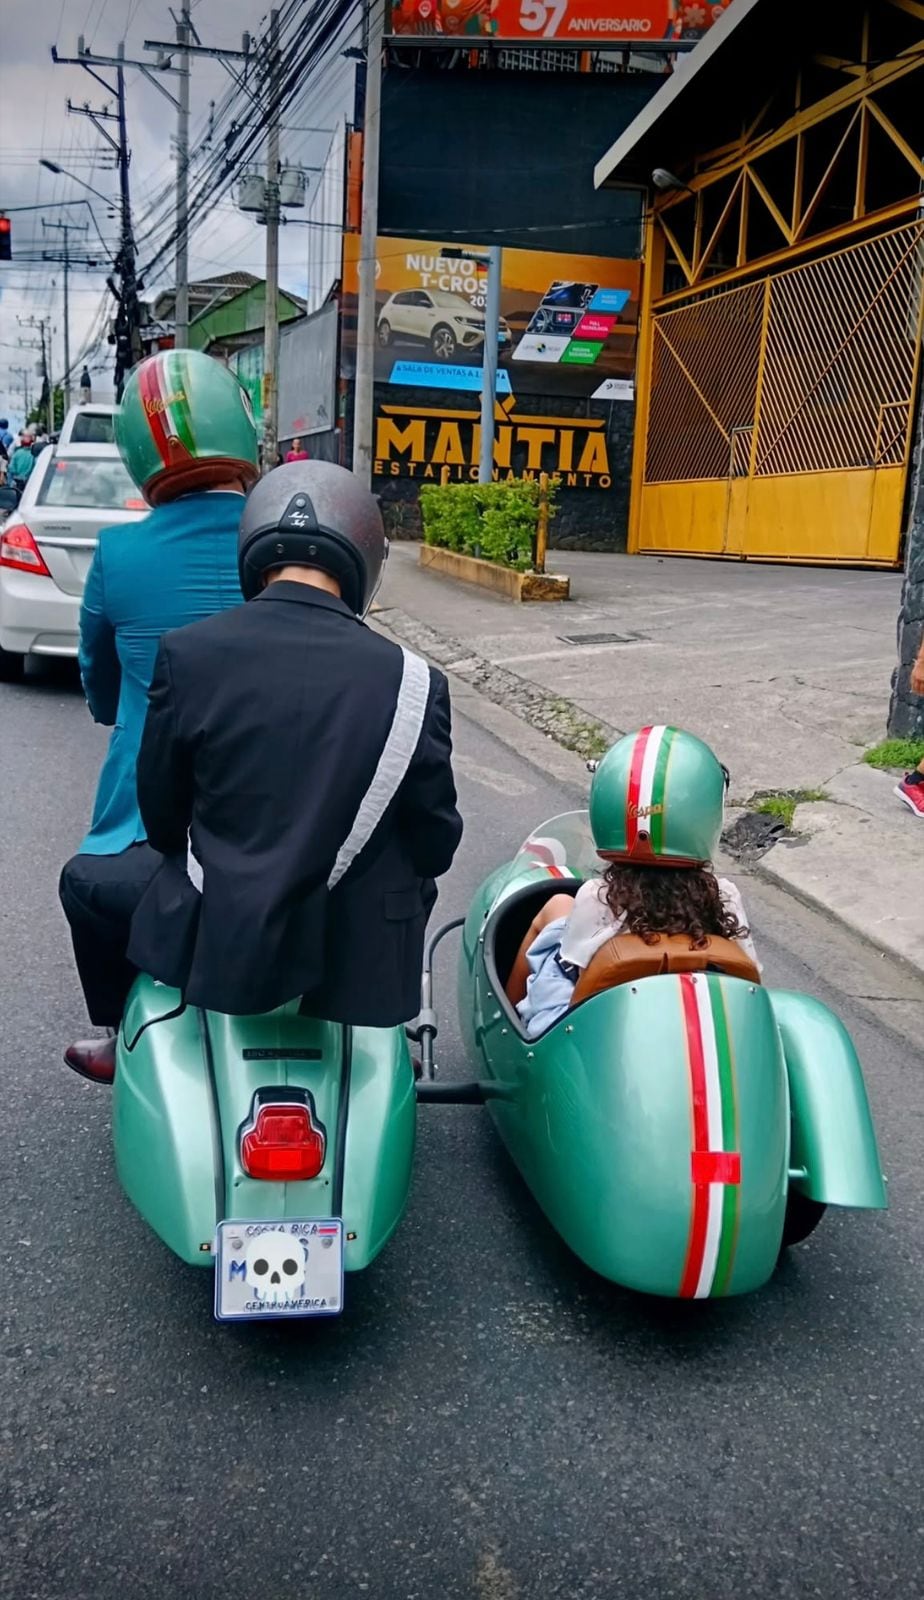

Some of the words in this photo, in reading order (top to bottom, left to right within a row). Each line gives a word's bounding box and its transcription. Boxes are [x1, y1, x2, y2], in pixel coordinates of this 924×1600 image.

[519, 0, 568, 37] 57
[568, 18, 651, 32] ANIVERSARIO
[406, 254, 475, 276] NUEVO
[419, 272, 488, 295] T-CROS
[424, 366, 433, 374] DE
[436, 367, 466, 377] VENTAS
[375, 417, 610, 474] MANTIA
[373, 460, 612, 488] ESTAIONAMENTO
[626, 801, 665, 820] Vespa
[291, 1223, 318, 1235] RICA
